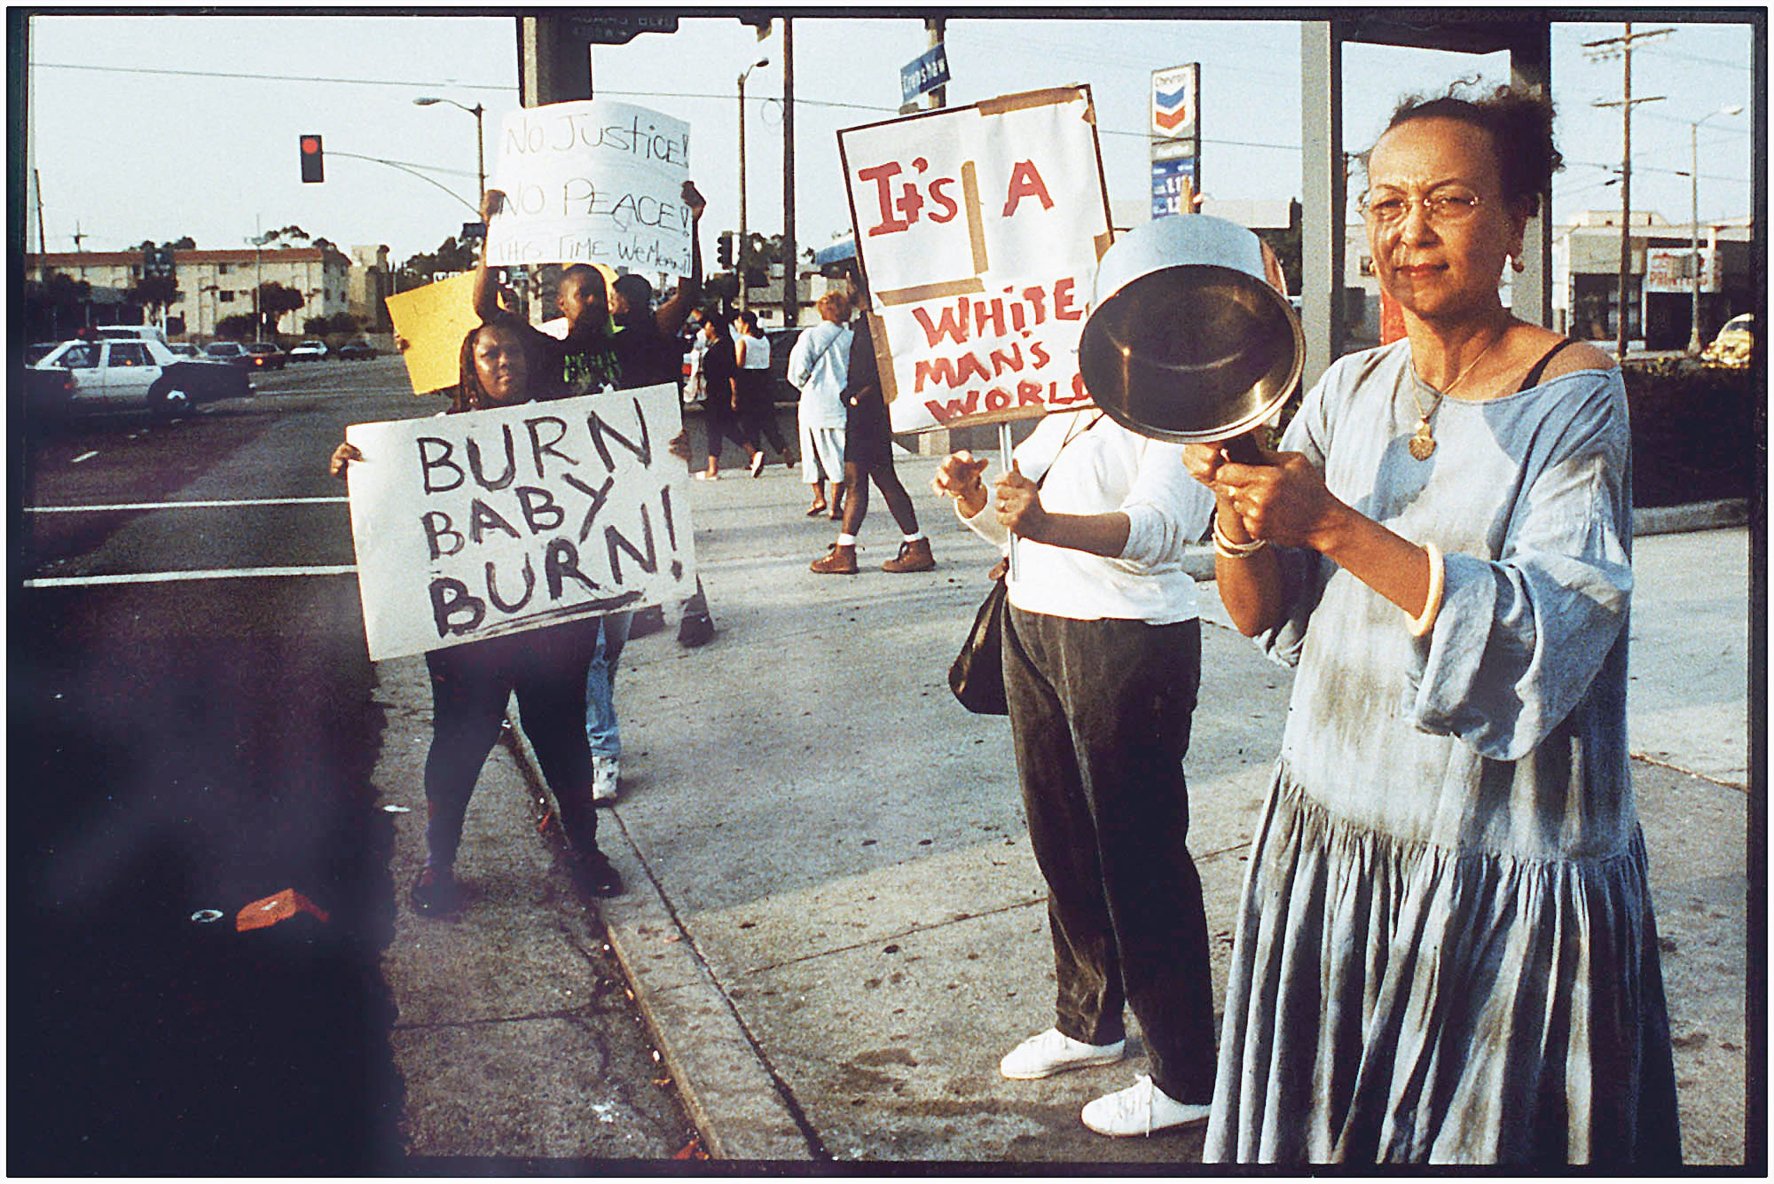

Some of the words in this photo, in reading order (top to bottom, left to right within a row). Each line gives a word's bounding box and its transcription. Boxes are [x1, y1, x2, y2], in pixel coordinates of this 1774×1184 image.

[506, 116, 545, 155] NO
[500, 181, 545, 216] NO
[564, 177, 690, 237] PEACE!
[858, 157, 958, 237] It's
[1002, 159, 1054, 217] A
[416, 397, 653, 496] BURN
[421, 473, 614, 560] BABY
[428, 485, 684, 639] BURN!
